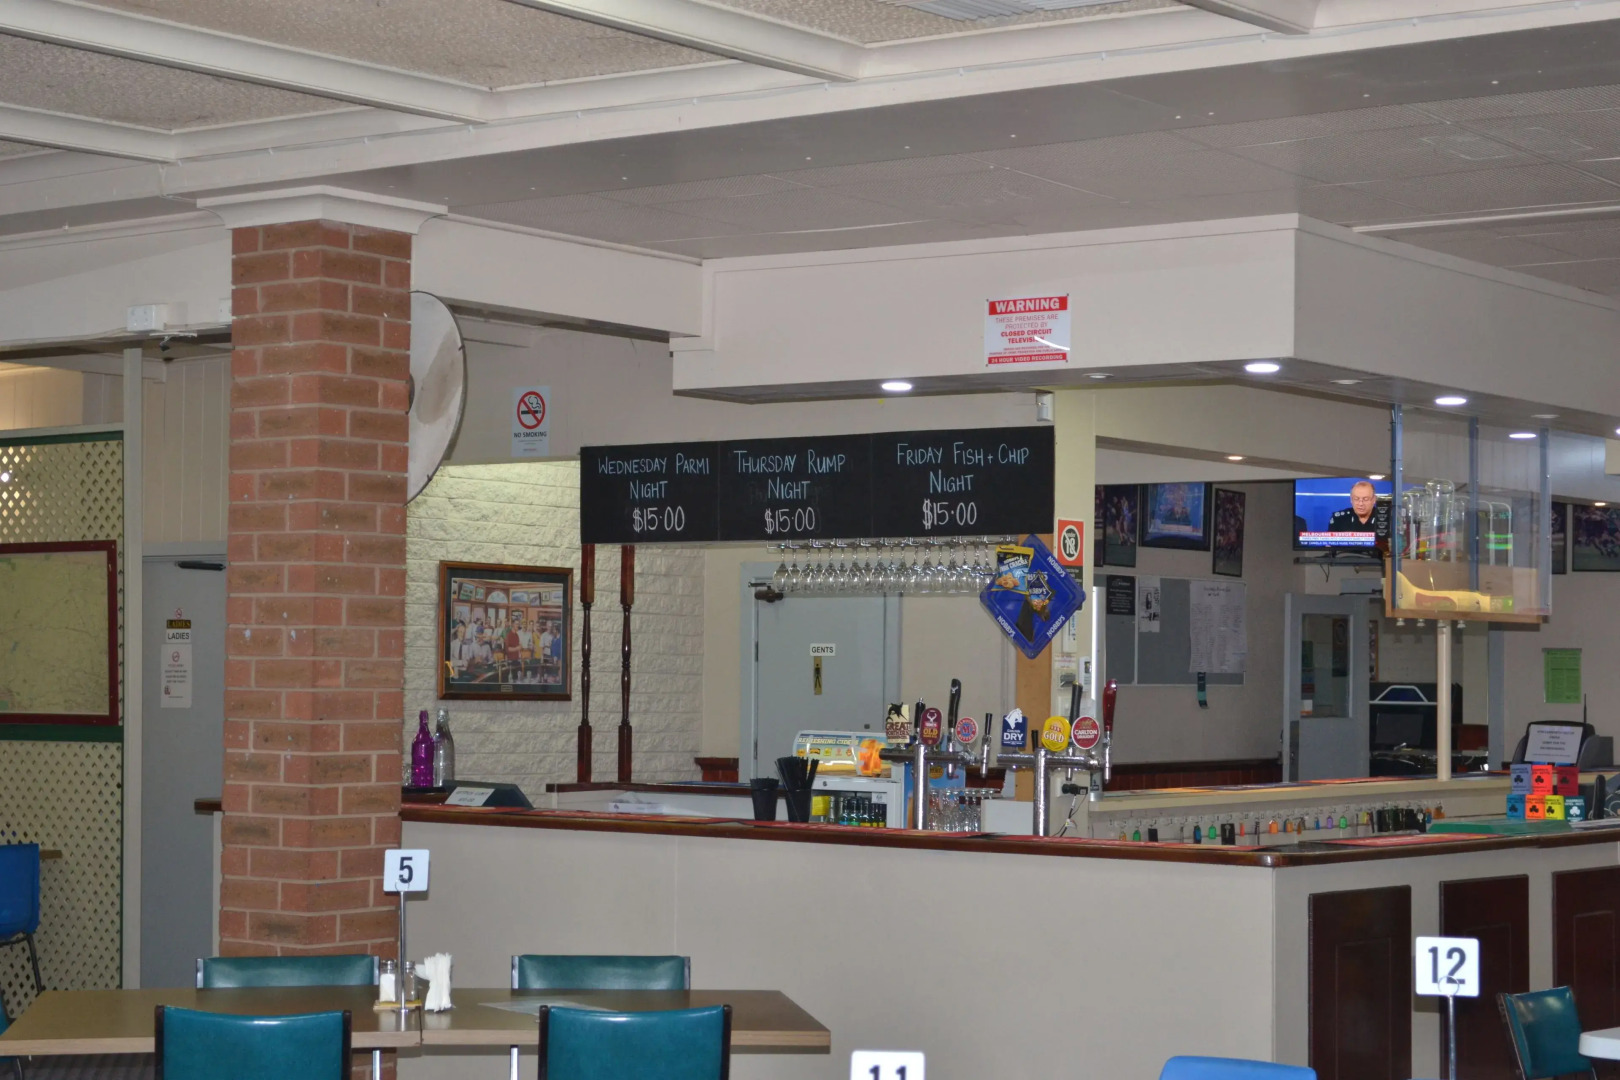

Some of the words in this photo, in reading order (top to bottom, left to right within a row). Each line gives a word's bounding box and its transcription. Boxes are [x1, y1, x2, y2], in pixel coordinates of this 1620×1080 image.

[995, 298, 1060, 313] WARNING
[598, 456, 667, 474] WEDNESDAY
[676, 453, 709, 474] PARMI
[733, 450, 796, 473] THURSDAY
[808, 449, 846, 474] RUMP
[897, 444, 942, 465] FRIDAY
[954, 442, 984, 467] FISH
[998, 443, 1029, 464] CHIP
[630, 480, 668, 499] NIGHT
[768, 476, 810, 499] NIGHT
[930, 469, 974, 493] NIGHT
[1043, 731, 1064, 743] GOLD
[399, 856, 413, 883] 5
[1428, 946, 1466, 984] 12
